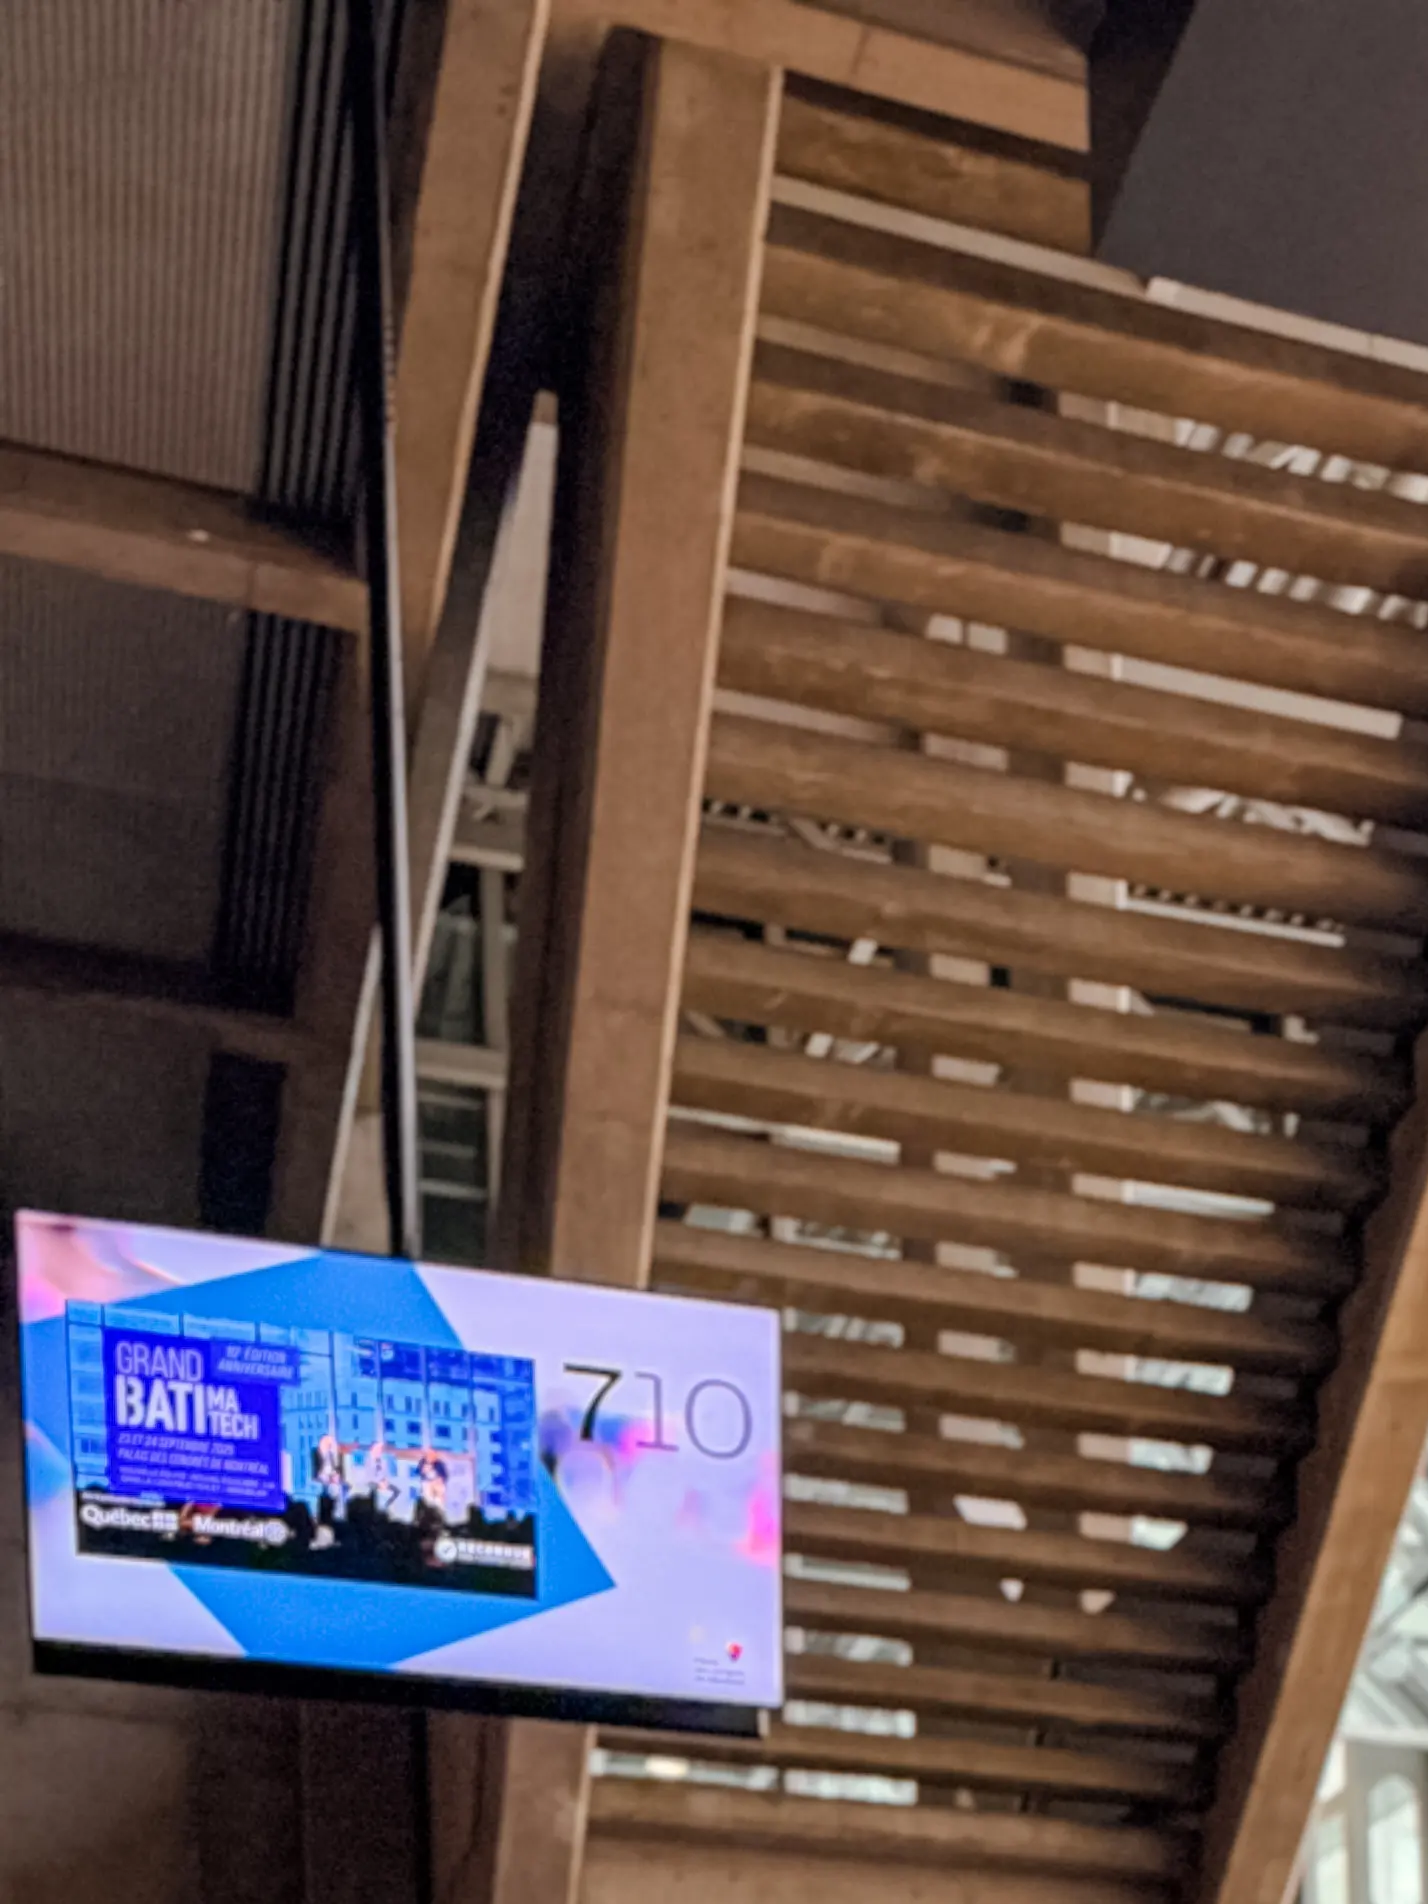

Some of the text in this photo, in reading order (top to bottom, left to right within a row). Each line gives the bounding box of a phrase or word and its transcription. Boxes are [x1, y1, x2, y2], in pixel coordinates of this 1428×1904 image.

[117, 1343, 204, 1382] GRAND
[116, 1375, 205, 1434] BATI
[209, 1387, 240, 1412] MA
[563, 1362, 753, 1460] 710
[210, 1412, 259, 1440] TECH
[82, 1504, 151, 1529] Québec
[194, 1517, 264, 1537] Montréal
